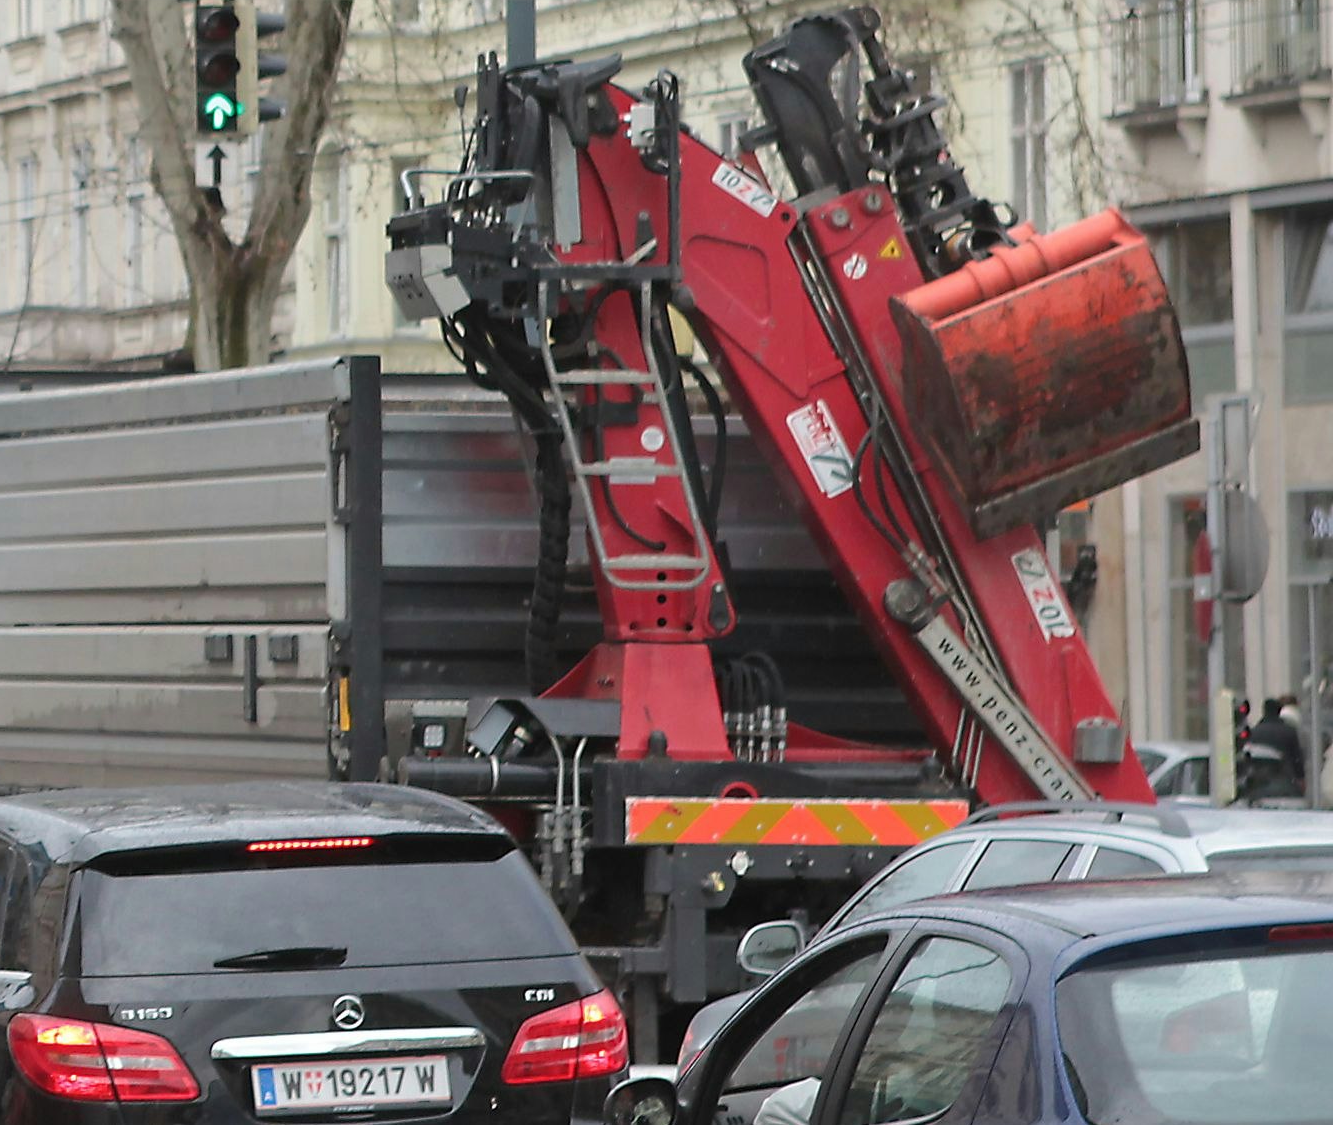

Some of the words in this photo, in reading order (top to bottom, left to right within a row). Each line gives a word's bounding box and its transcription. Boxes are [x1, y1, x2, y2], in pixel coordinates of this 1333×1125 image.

[938, 637, 1076, 805] www.penz-cran
[282, 1071, 302, 1100] W
[327, 1066, 406, 1098] 19217
[415, 1064, 435, 1094] W
